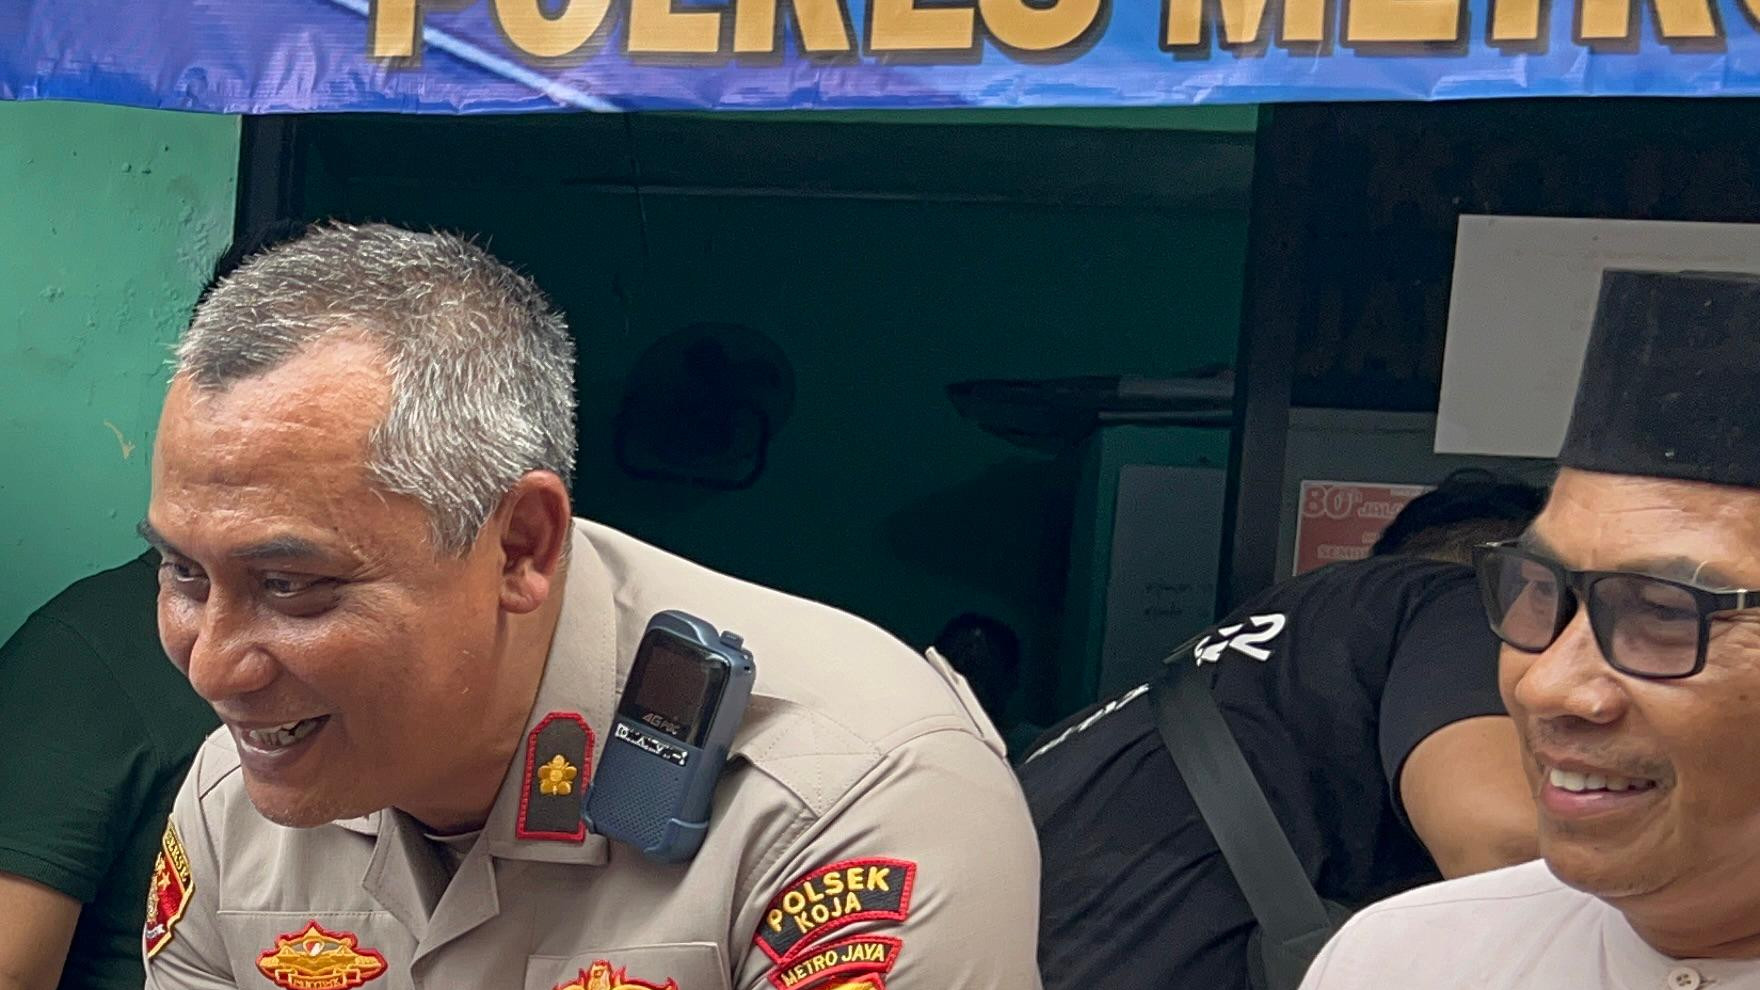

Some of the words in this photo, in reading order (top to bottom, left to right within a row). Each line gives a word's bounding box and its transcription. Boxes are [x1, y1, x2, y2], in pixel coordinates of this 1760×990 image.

[767, 866, 890, 933] POLSEK
[795, 891, 862, 933] KOJA
[781, 949, 839, 987] METRO
[841, 943, 885, 963] JAYA
